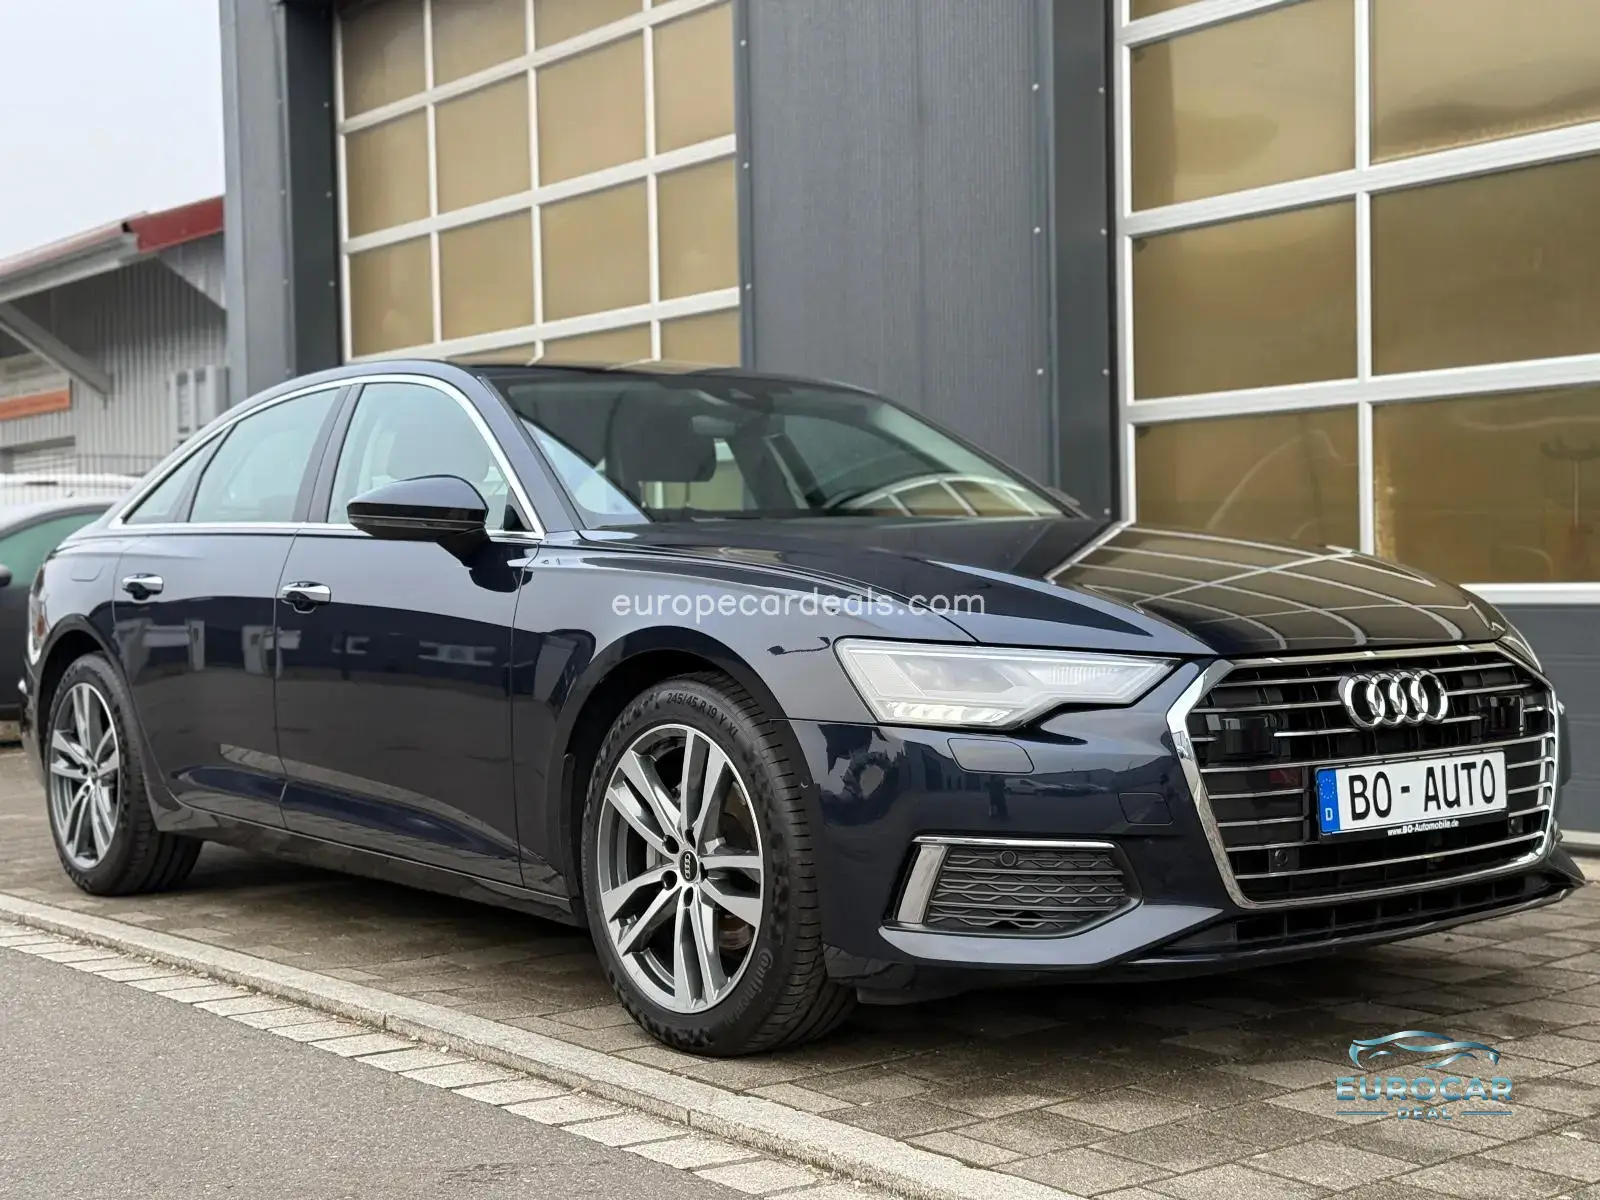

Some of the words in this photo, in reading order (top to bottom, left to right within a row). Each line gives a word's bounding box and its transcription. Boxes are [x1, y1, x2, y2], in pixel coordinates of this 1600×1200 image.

[667, 692, 698, 708] 245/45
[1348, 771, 1392, 821] BO
[1424, 758, 1496, 812] AUTO
[1325, 807, 1333, 821] D
[1387, 819, 1459, 836] www.BO-Automobile.de
